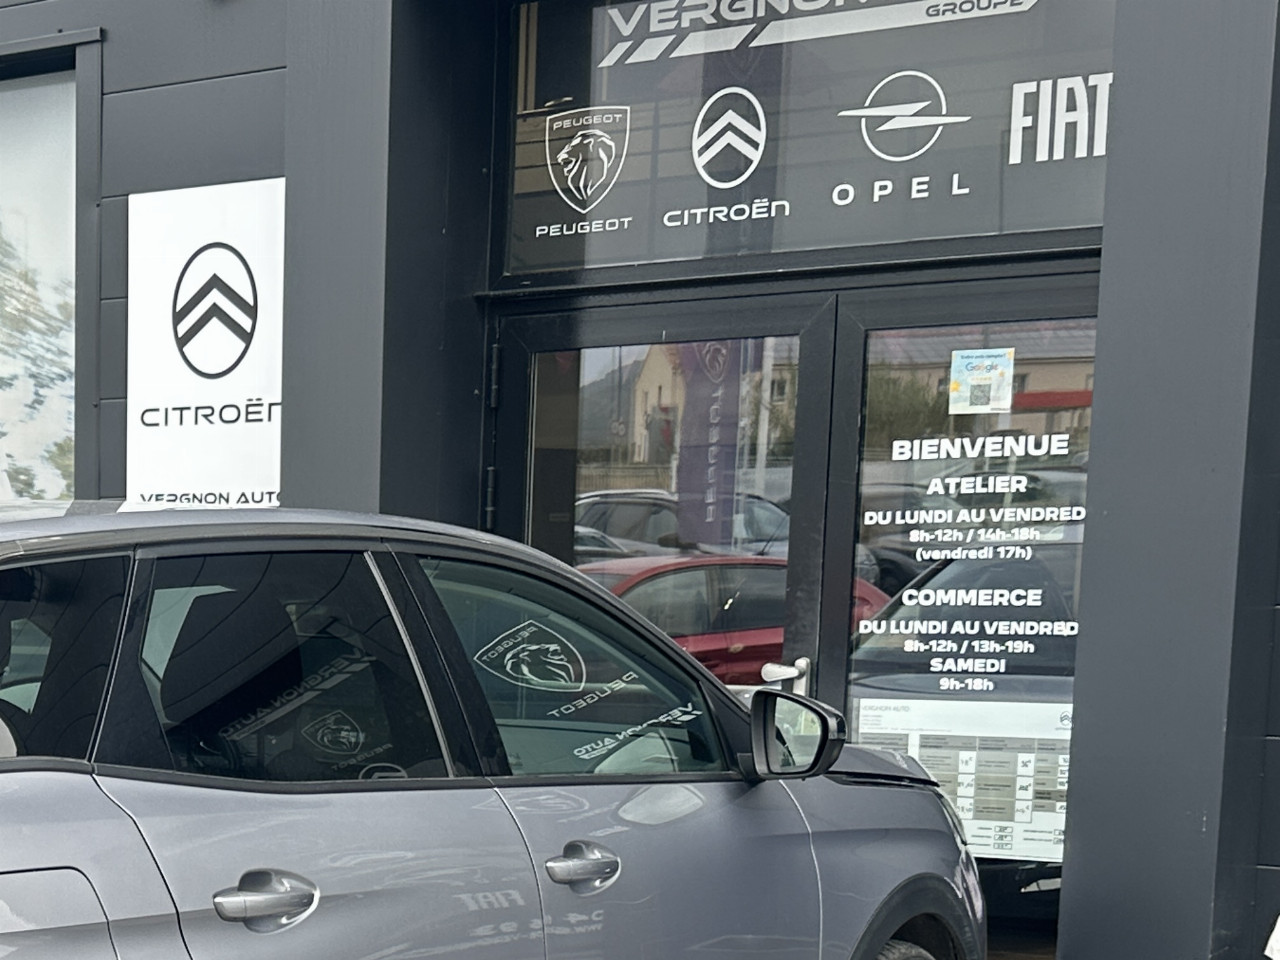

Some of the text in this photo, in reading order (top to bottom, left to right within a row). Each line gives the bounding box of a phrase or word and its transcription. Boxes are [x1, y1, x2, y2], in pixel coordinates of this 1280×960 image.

[607, 0, 870, 36] VERGN
[553, 114, 623, 131] PEUGEOT
[1009, 72, 1114, 165] FIAT
[832, 173, 970, 206] OPEL
[535, 217, 633, 238] PEUGEOT
[891, 434, 1070, 461] BIENVENUE
[926, 475, 1028, 495] ATELIER
[864, 511, 892, 525] DU
[894, 510, 952, 525] LUNDI
[956, 508, 985, 523] AU
[909, 528, 964, 543] 8h-12h
[977, 528, 1040, 542] 14h-18h
[915, 546, 1033, 561] (vendredi 17h)
[902, 589, 1043, 607] COMMERCE
[859, 620, 887, 634] DU
[890, 620, 947, 635] LUNDI
[951, 620, 980, 635] AU
[903, 639, 958, 653] 8h-12h
[971, 640, 1035, 653] 13h-19h
[929, 658, 1006, 673] SAMEDI
[939, 678, 994, 691] 9h-18h
